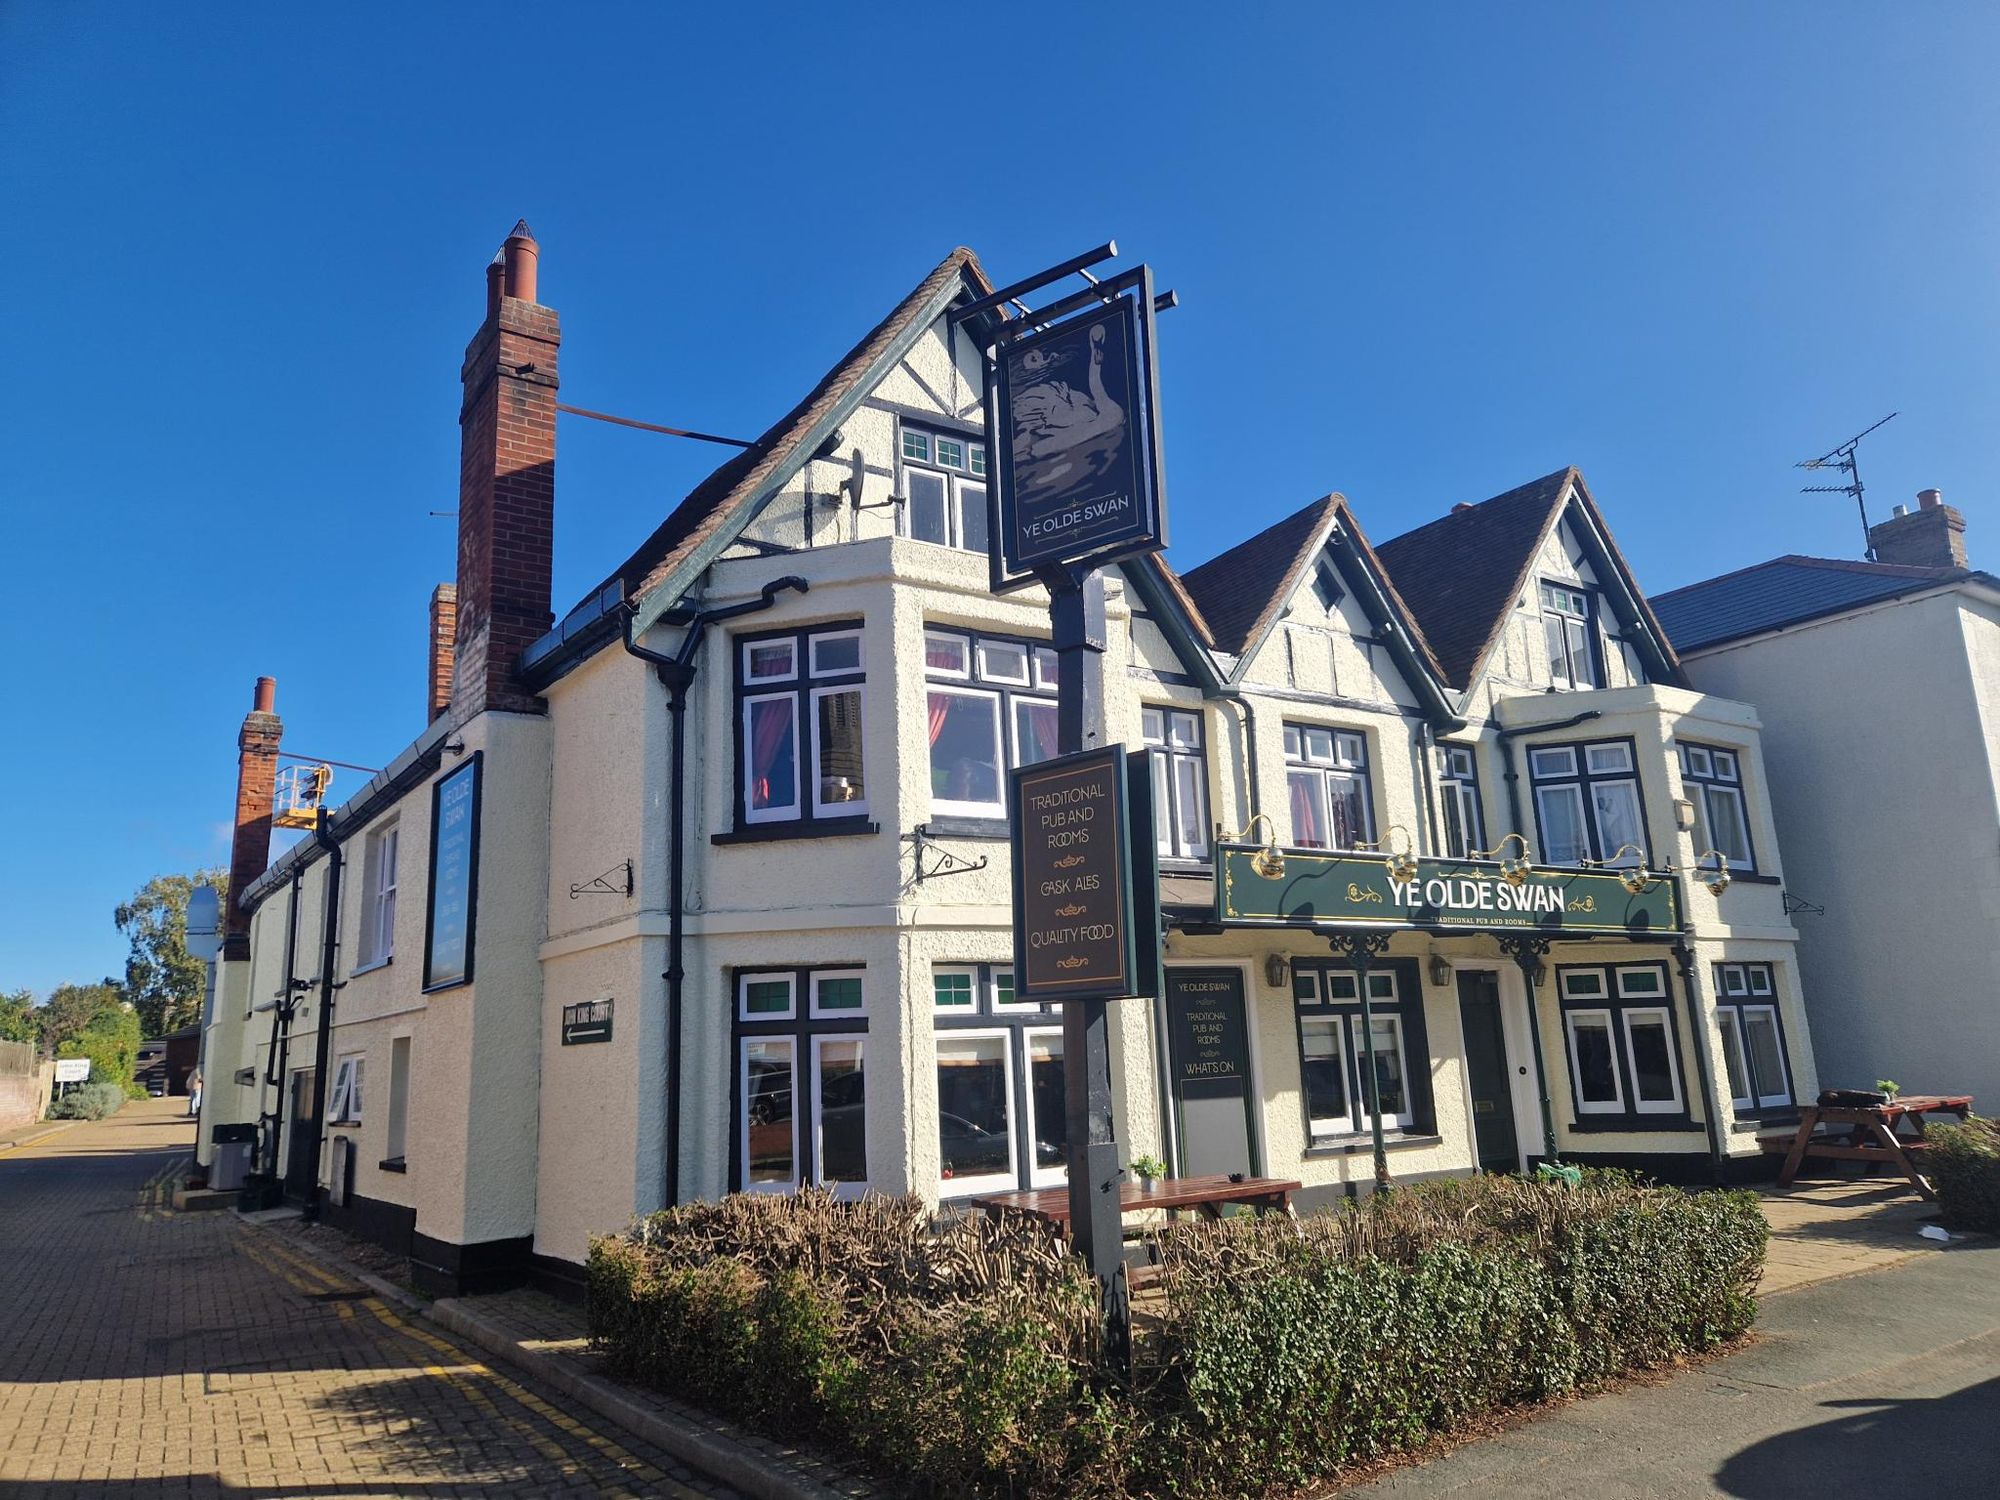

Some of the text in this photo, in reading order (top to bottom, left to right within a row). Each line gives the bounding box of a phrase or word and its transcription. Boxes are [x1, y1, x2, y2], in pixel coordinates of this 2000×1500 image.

[1023, 495, 1129, 538] YE OLDE SWAN
[1030, 784, 1105, 810] TRADITIONAL
[1041, 807, 1094, 829] PUB AND
[1048, 828, 1089, 848] ROOMS
[1041, 874, 1100, 896] CASK ALES
[1386, 877, 1566, 912] YE OLDE SWAN
[1432, 916, 1475, 924] TRADITIONAL
[1031, 924, 1114, 948] QUALITY FOOD
[1178, 983, 1230, 992] YE OLDE SWAN
[1186, 1012, 1227, 1021] TRADITIONAL
[1192, 1023, 1223, 1033] PUB AND
[1197, 1035, 1220, 1045] ROOMS
[1219, 1060, 1235, 1072] ON
